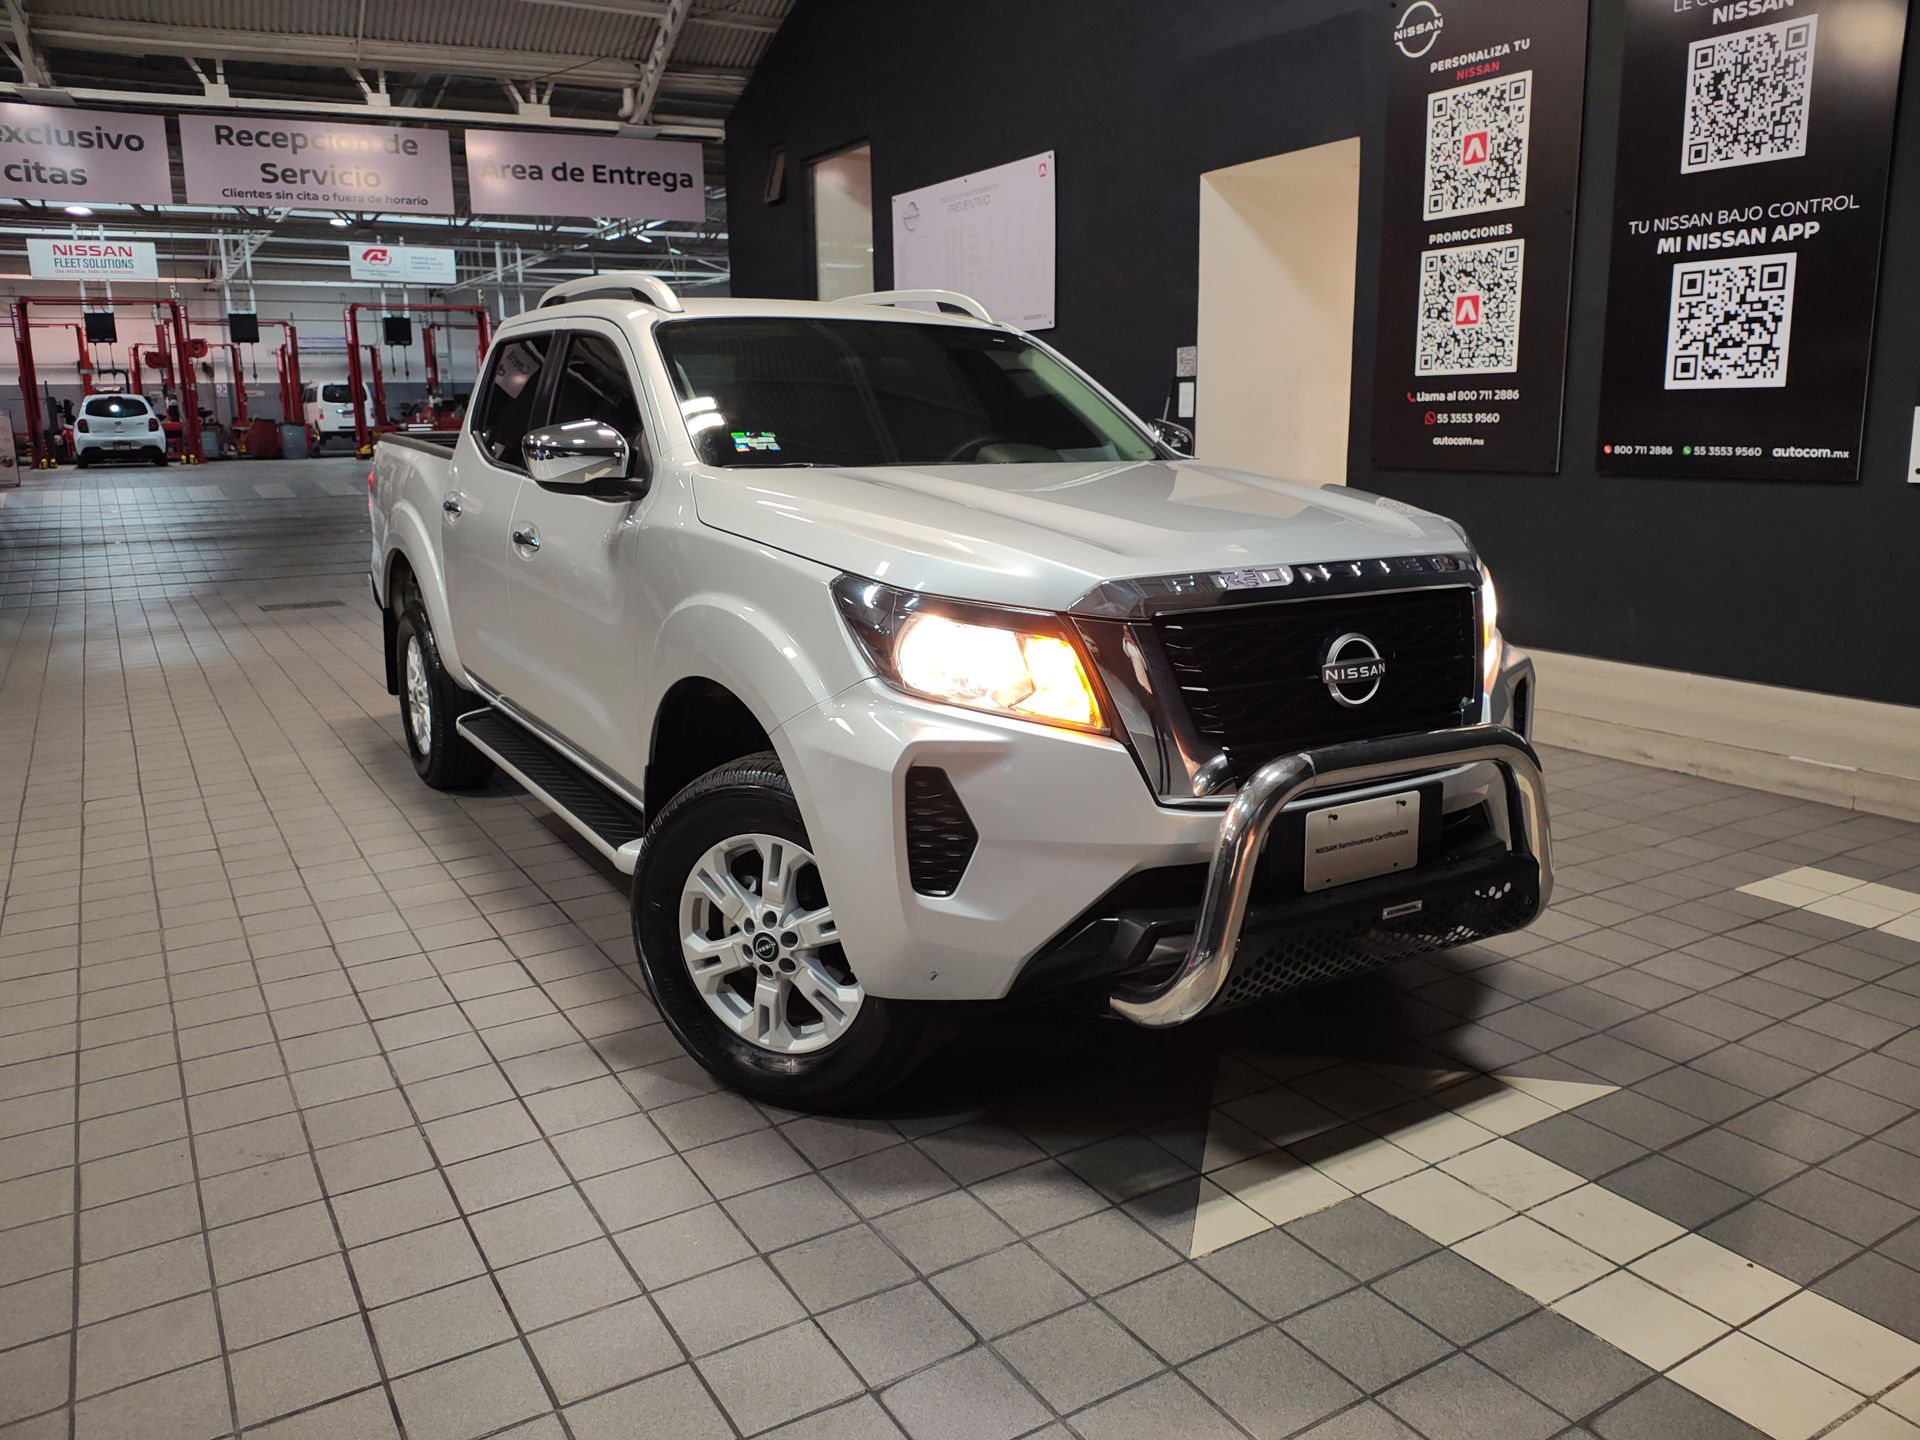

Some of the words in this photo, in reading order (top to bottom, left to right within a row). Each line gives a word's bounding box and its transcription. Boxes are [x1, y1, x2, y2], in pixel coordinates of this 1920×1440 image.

[1393, 18, 1444, 41] NISSAN
[1429, 43, 1511, 74] PERSONALIZA
[1513, 38, 1531, 52] TU
[1456, 61, 1500, 80] NISSAN
[0, 122, 145, 152] xclusivo
[382, 133, 419, 155] de
[4, 158, 88, 186] citas
[260, 162, 381, 188] Servicio
[551, 162, 585, 182] de
[592, 164, 694, 193] Entrega
[222, 188, 273, 199] Clientes
[275, 190, 294, 200] sin
[296, 191, 319, 202] cita
[322, 194, 330, 202] o
[332, 193, 365, 204] fuera
[368, 195, 383, 204] de
[385, 195, 429, 206] horario
[1629, 220, 1650, 235] TU
[1654, 212, 1713, 232] NISSAN
[1717, 206, 1763, 225] BAJO
[1767, 195, 1860, 218] CONTROL
[1429, 223, 1513, 244] PROMOCIONES
[1656, 236, 1681, 254] MI
[1686, 226, 1767, 251] NISSAN
[1771, 221, 1821, 243] APP
[52, 244, 133, 257] NISSAN
[1416, 391, 1445, 402] Llama
[1446, 390, 1456, 401] al
[1457, 390, 1477, 401] 800
[1478, 390, 1492, 400] 711
[1494, 389, 1520, 400] 2886
[1436, 413, 1449, 424] 55
[1450, 413, 1473, 423] 3553
[1475, 412, 1500, 423] 9560
[1613, 445, 1633, 455] 800
[1634, 446, 1648, 455] 711
[1649, 446, 1673, 456] 2886
[1693, 446, 1706, 456] 55
[1708, 446, 1733, 456] 3553
[1735, 446, 1762, 457] 9560
[1772, 446, 1850, 459] autocom.mx
[1325, 662, 1386, 681] NISSAN
[1315, 843, 1337, 854] NISSAN
